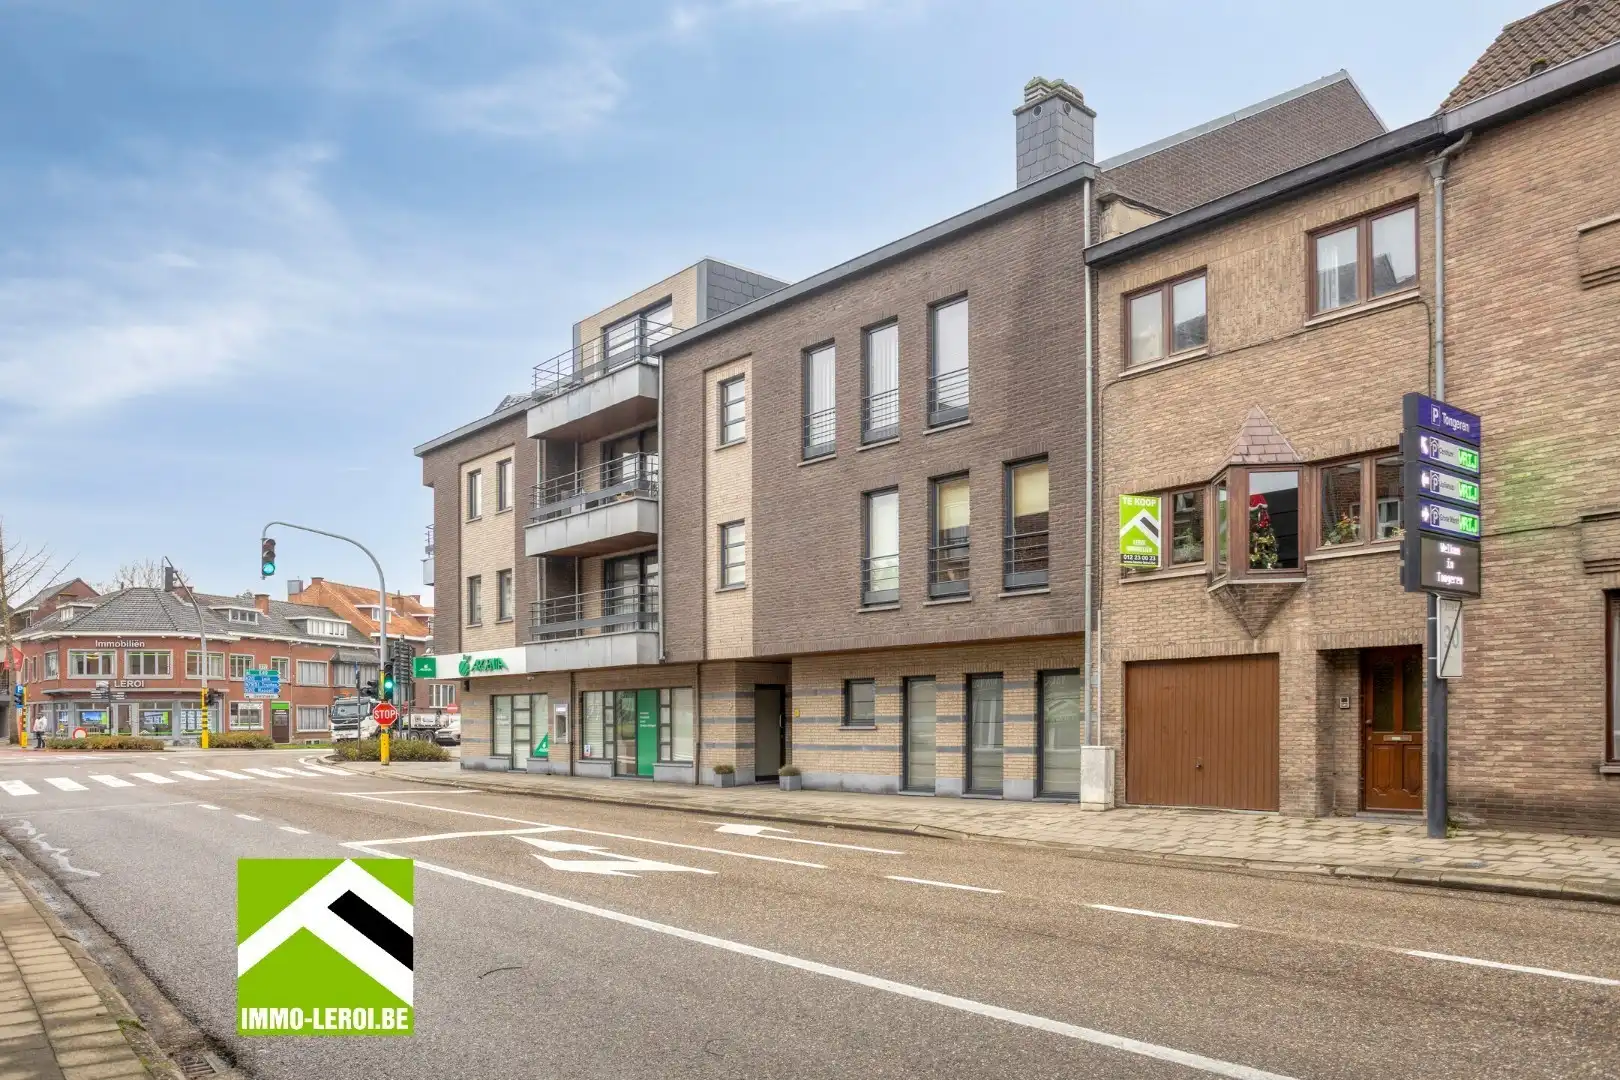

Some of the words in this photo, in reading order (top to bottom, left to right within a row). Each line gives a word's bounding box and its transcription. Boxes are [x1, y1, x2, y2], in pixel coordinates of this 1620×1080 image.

[1441, 412, 1470, 432] Tongeren
[1458, 450, 1478, 469] VRIJ
[1458, 482, 1478, 501] VRIJ
[1122, 496, 1132, 506] TE
[1134, 497, 1157, 508] KOOP
[1459, 515, 1478, 533] VRIJ
[1436, 571, 1464, 586] Tongeren
[95, 639, 145, 648] Immobiliën
[114, 679, 145, 688] LEROI
[374, 709, 396, 720] STOP
